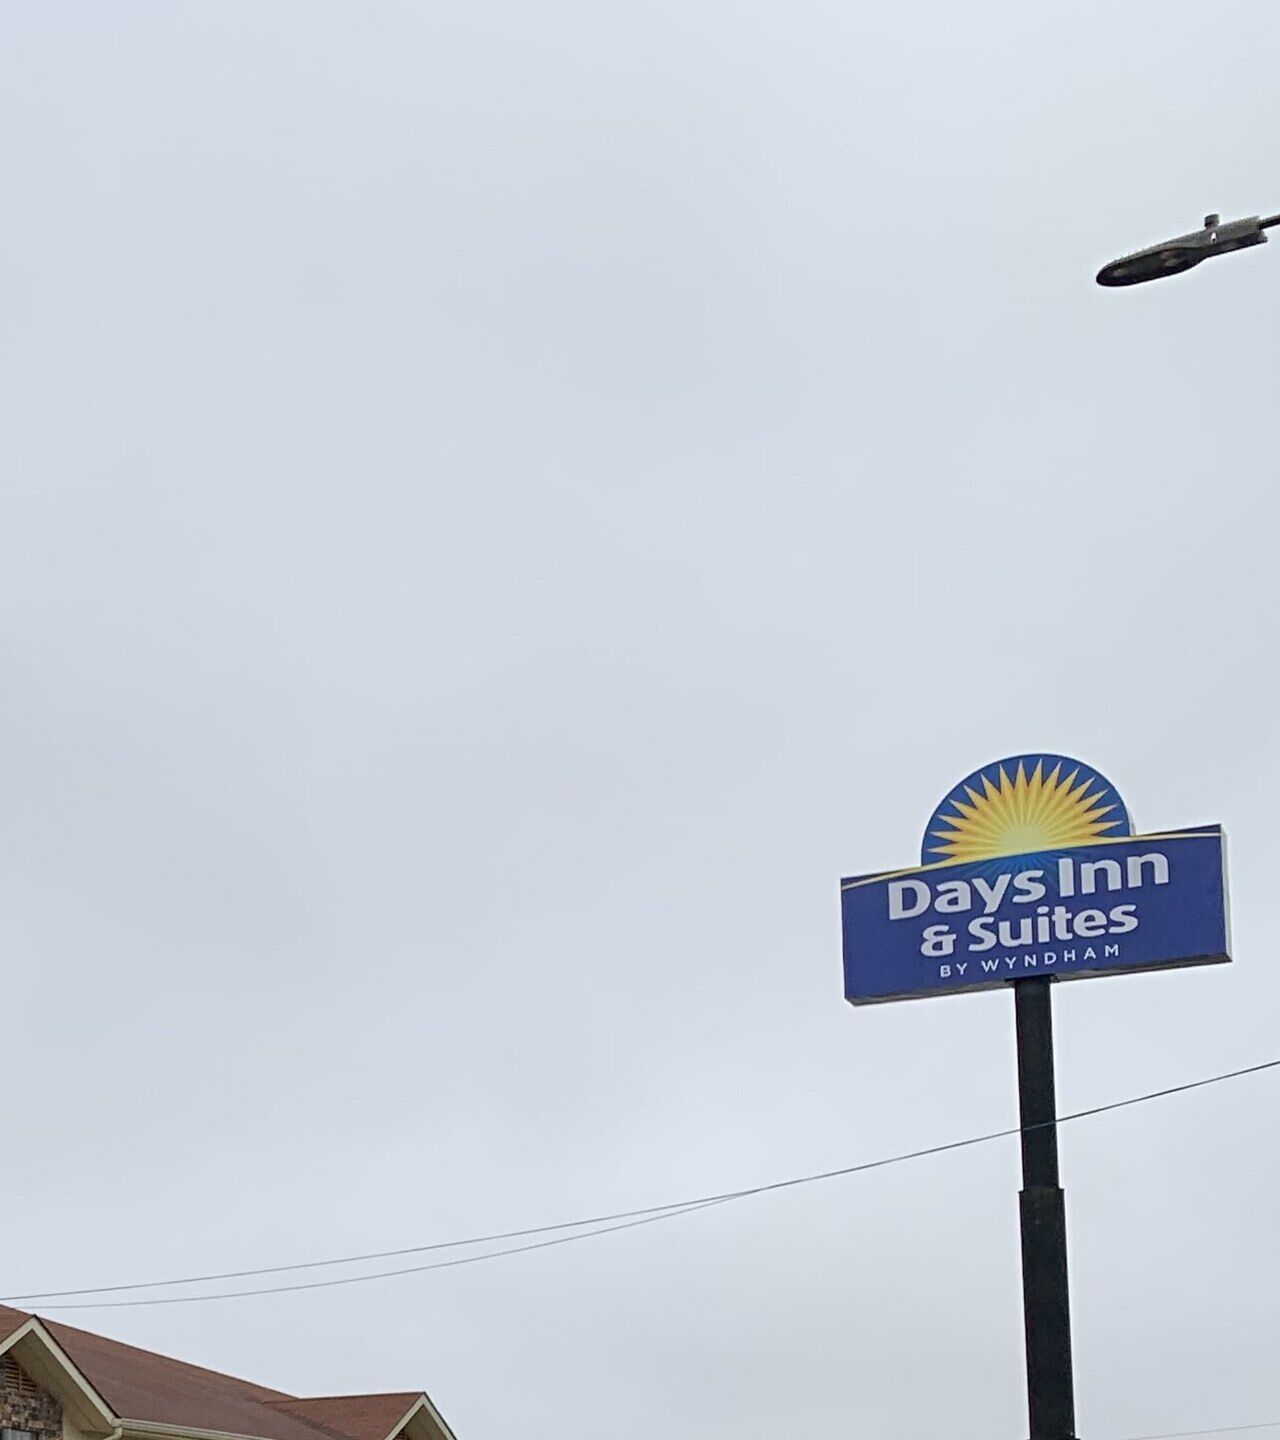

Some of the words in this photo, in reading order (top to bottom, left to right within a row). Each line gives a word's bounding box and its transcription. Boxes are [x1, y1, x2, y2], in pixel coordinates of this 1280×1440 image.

[889, 869, 1045, 920] Days
[1058, 852, 1169, 898] Inn
[920, 925, 956, 957] &
[968, 904, 1139, 951] Suites
[940, 962, 968, 977] BY
[981, 944, 1120, 972] WYNDHAM
